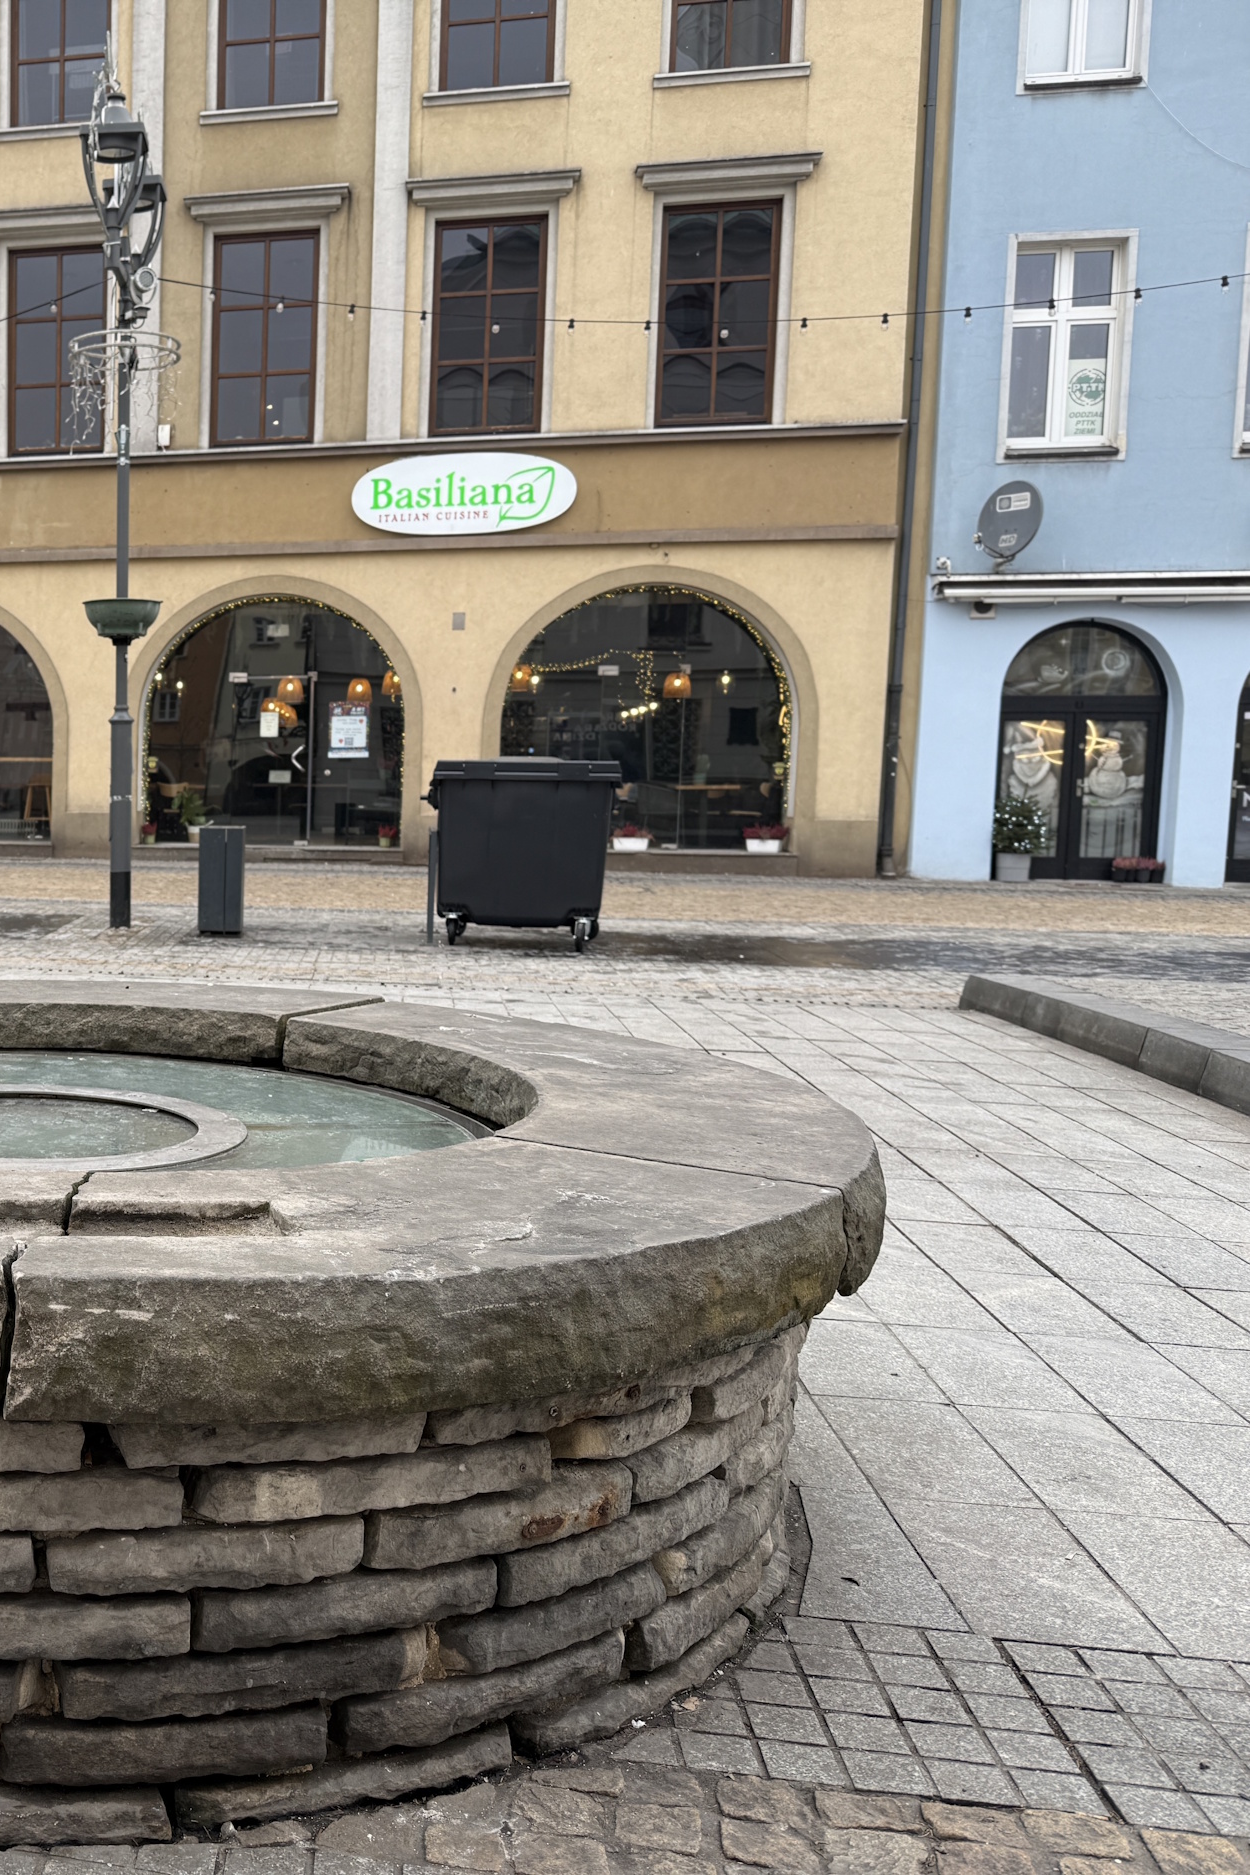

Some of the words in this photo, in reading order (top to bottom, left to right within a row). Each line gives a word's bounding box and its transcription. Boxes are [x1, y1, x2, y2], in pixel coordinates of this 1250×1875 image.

[1075, 419, 1096, 427] PTTK
[370, 471, 536, 510] Basiliana
[378, 513, 430, 523] ITALIAN
[436, 511, 489, 521] CUISINE
